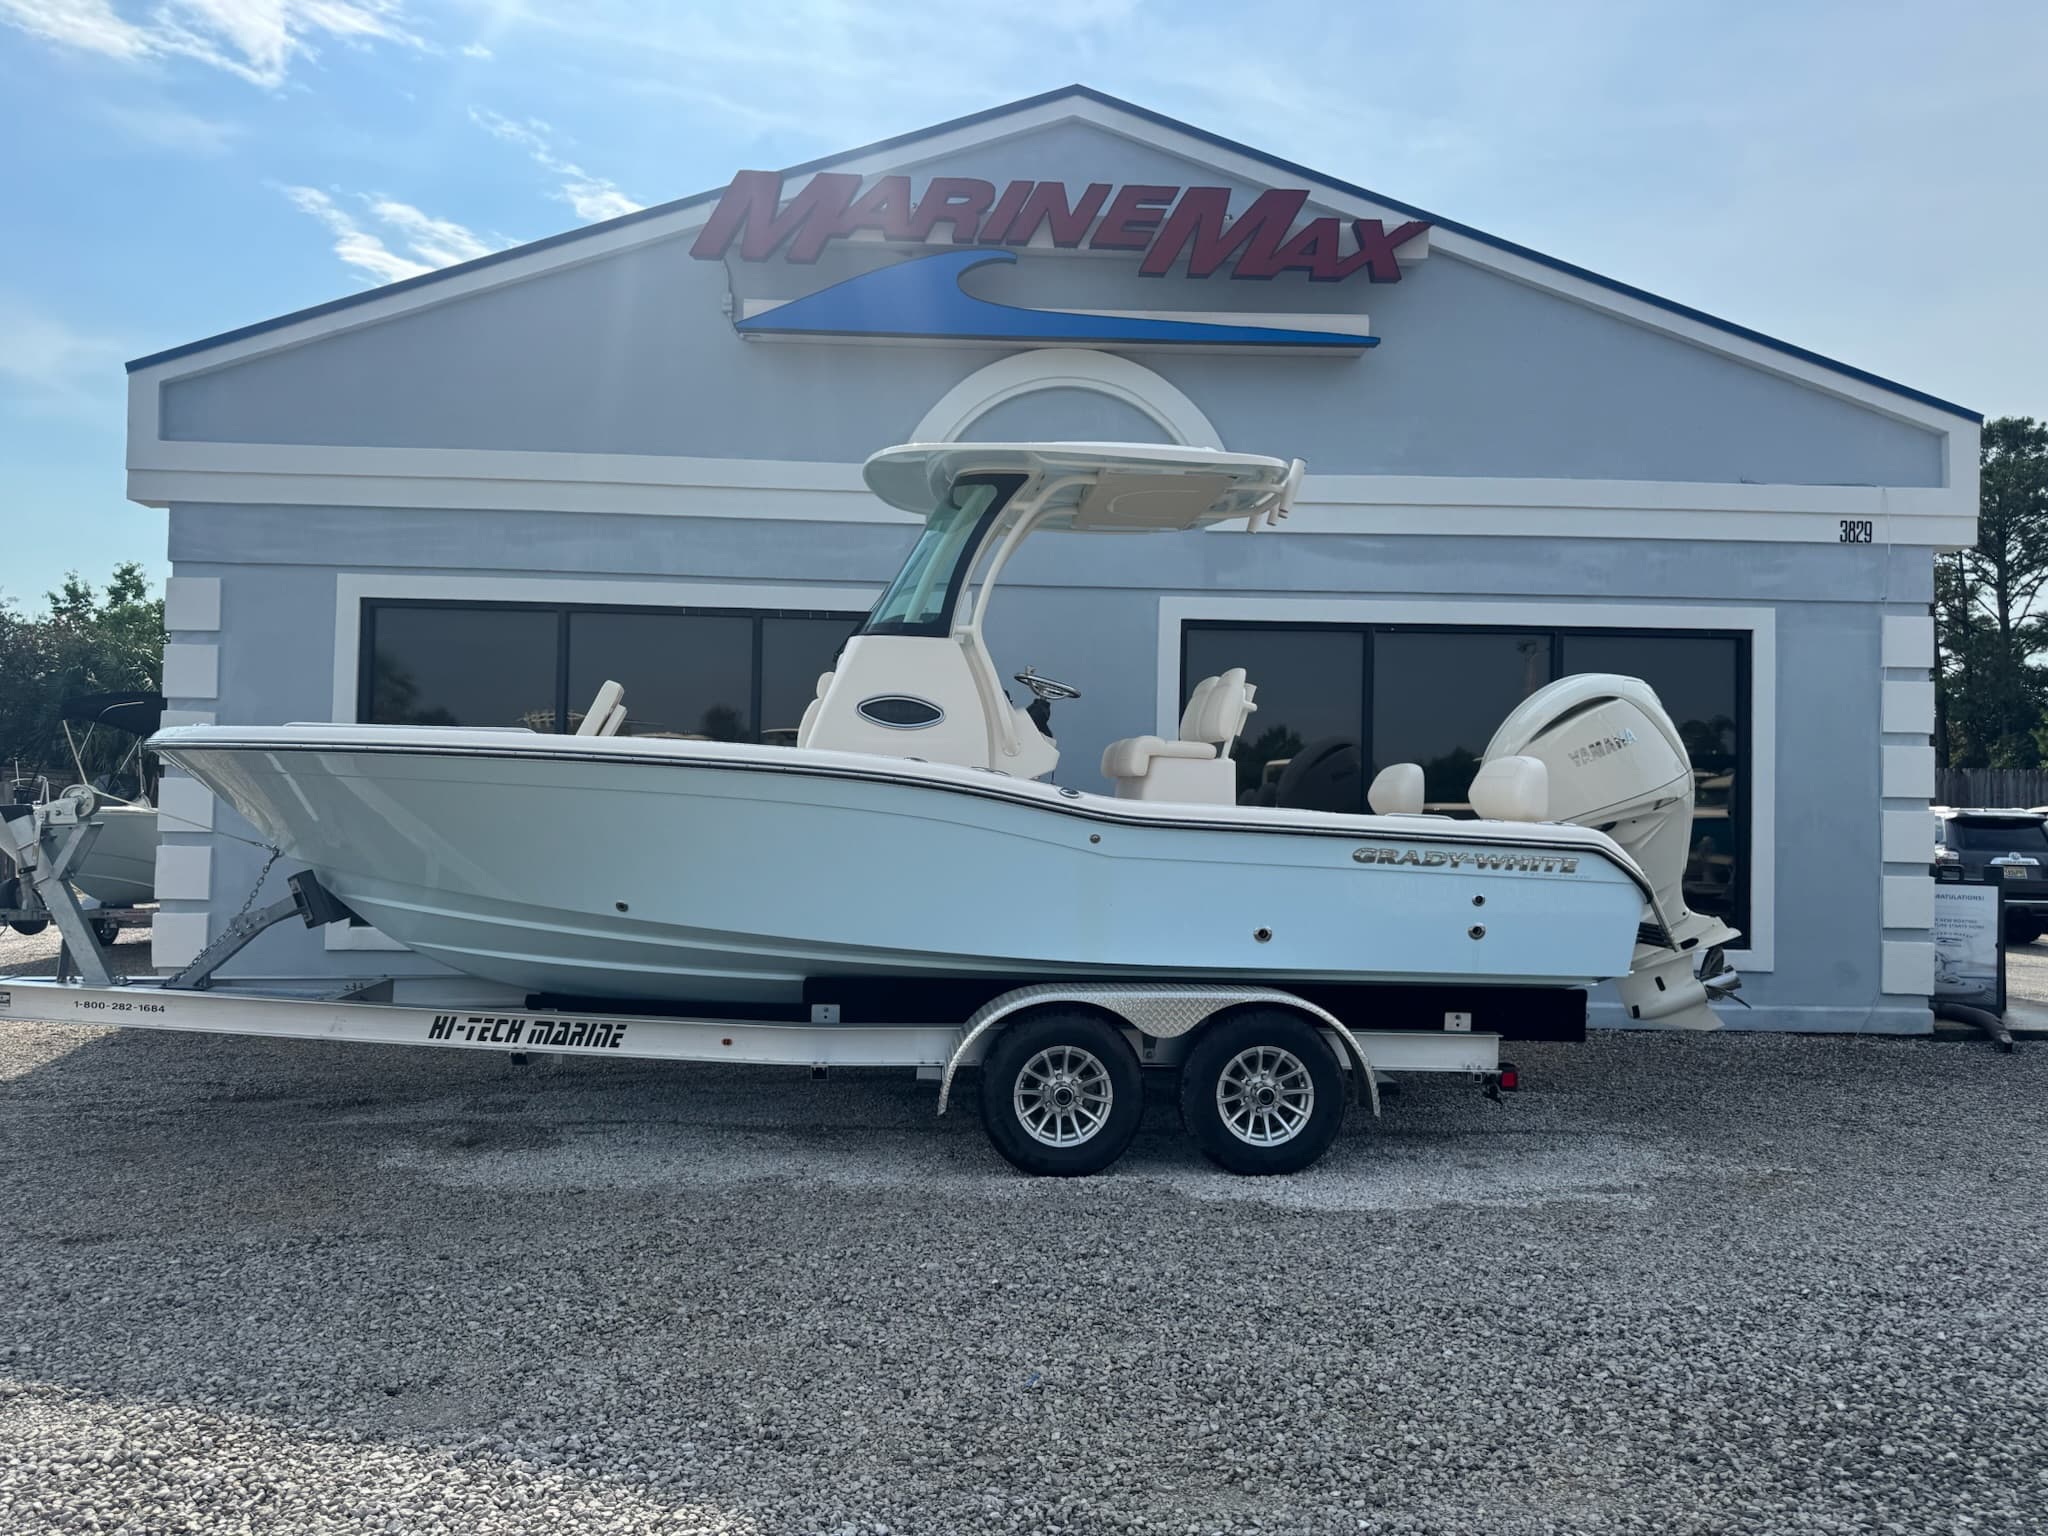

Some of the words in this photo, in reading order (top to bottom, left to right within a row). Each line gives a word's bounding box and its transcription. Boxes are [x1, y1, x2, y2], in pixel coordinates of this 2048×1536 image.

[1840, 520, 1872, 543] 3829
[1568, 728, 1637, 767] YAMAHA
[1352, 847, 1579, 874] GRADY-WHITE
[74, 1001, 165, 1013] 1-800-282-1684
[428, 1015, 525, 1043] HI-TECH
[527, 1020, 627, 1048] MARINE
